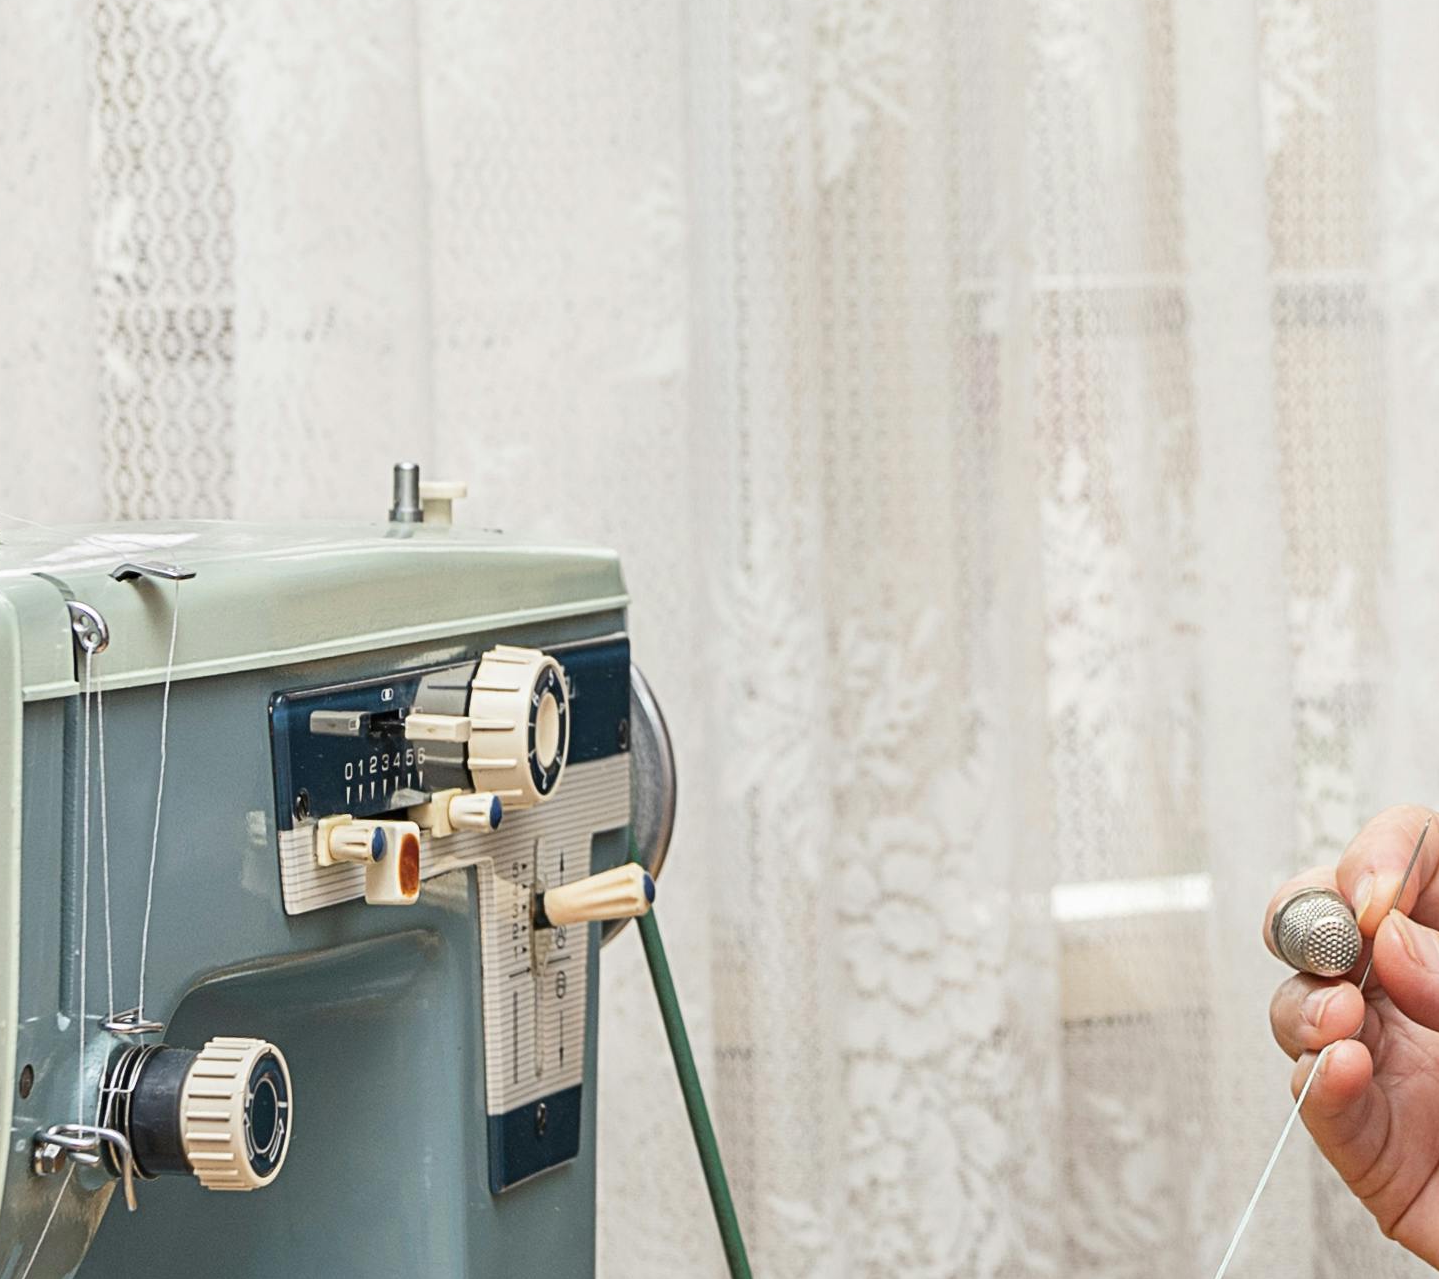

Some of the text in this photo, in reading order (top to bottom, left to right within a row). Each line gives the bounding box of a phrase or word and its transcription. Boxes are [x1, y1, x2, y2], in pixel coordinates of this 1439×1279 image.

[345, 747, 426, 781] 0 1 2 3 4 5 6
